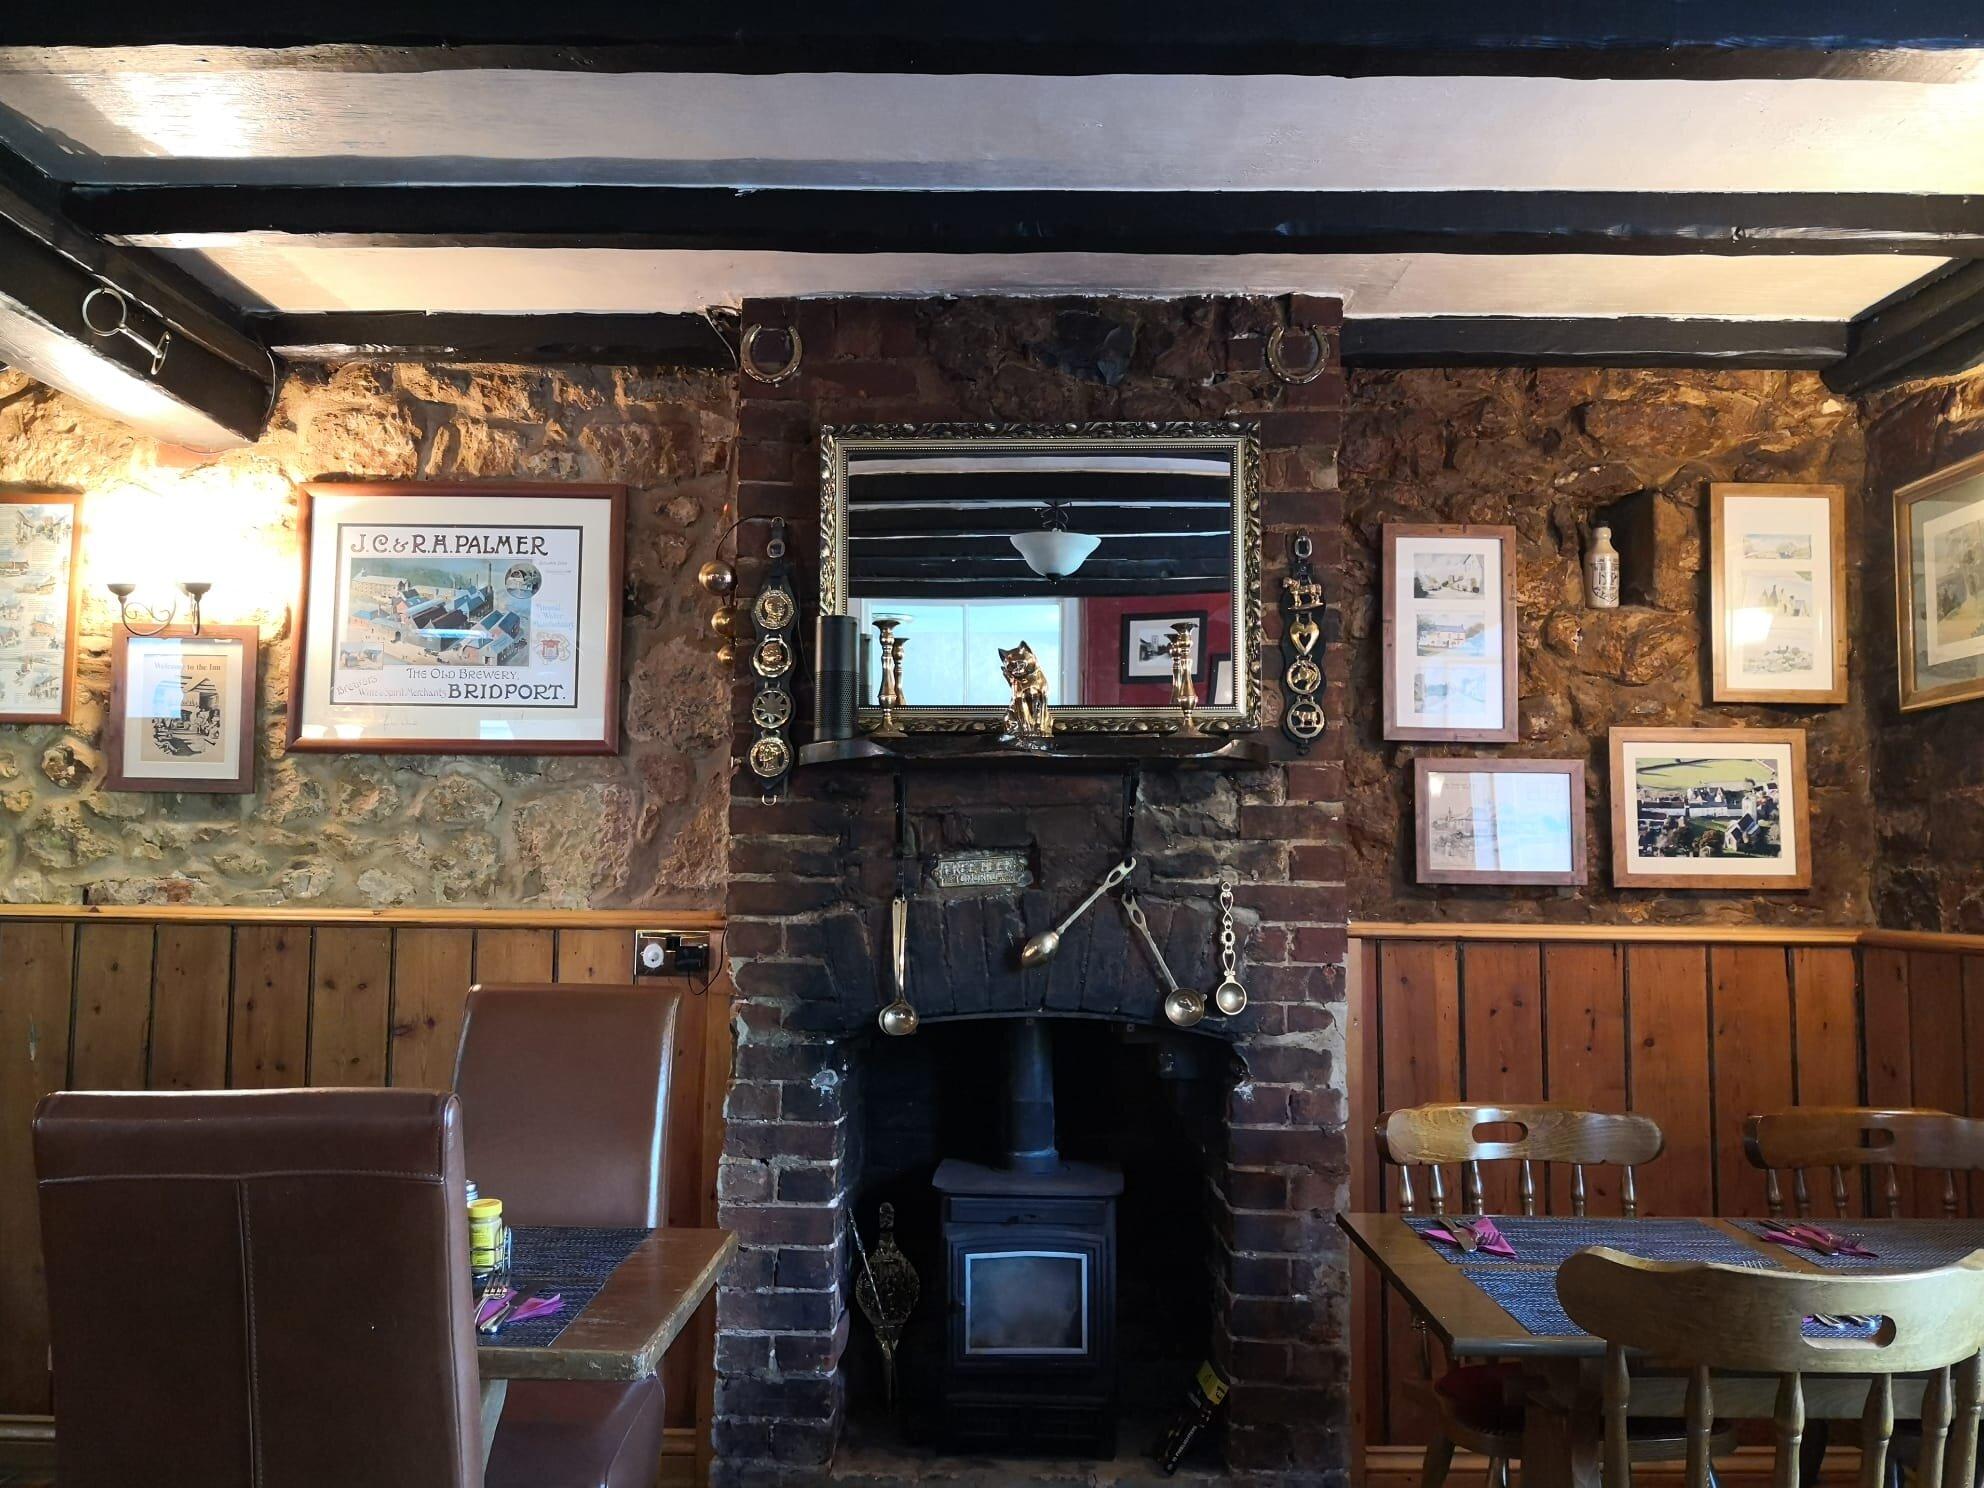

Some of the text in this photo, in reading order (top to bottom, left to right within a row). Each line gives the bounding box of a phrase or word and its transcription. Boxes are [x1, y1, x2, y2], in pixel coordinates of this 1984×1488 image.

[187, 663, 195, 671] to
[196, 663, 207, 671] the
[209, 663, 221, 671] Inn
[448, 683, 566, 700] BRIDPORT.
